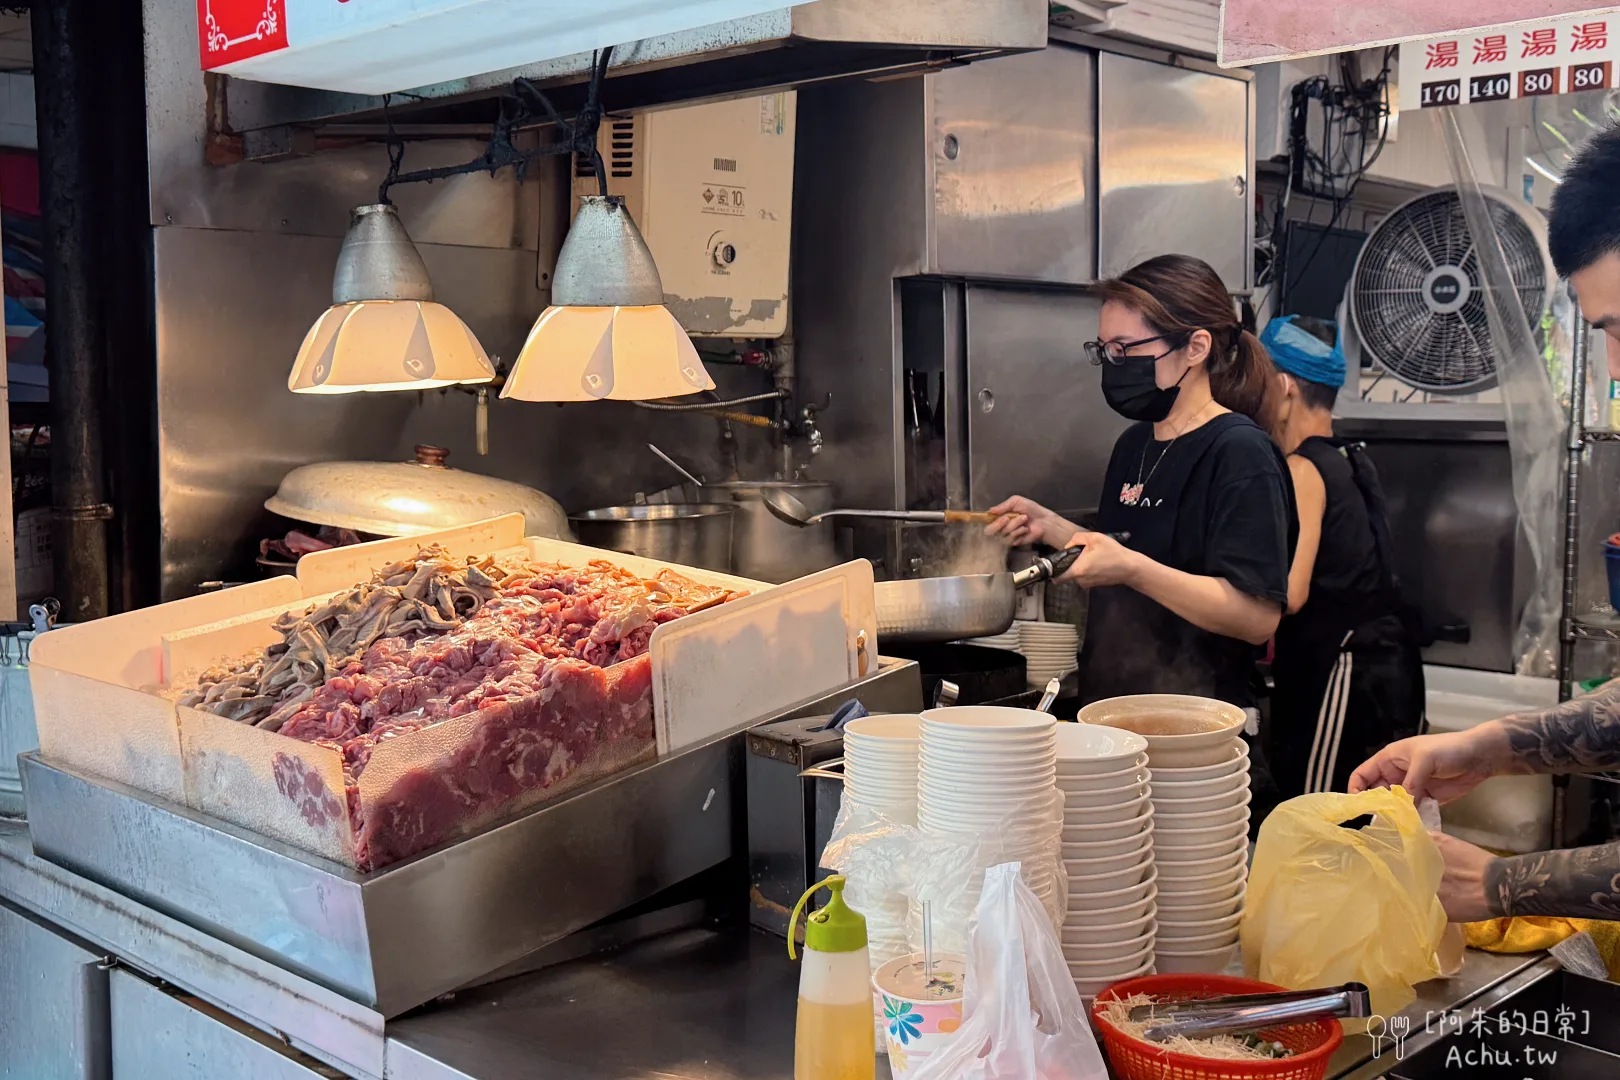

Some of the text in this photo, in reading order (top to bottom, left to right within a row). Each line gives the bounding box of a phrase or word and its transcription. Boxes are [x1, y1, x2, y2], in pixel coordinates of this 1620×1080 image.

[1521, 28, 1557, 58] 湯
[1570, 22, 1608, 52] 湯
[1425, 41, 1459, 70] 湯
[1472, 35, 1507, 65] 湯
[1470, 78, 1509, 98] 140
[1524, 73, 1552, 92] 80
[1574, 67, 1603, 87] 80
[1422, 84, 1459, 104] 170
